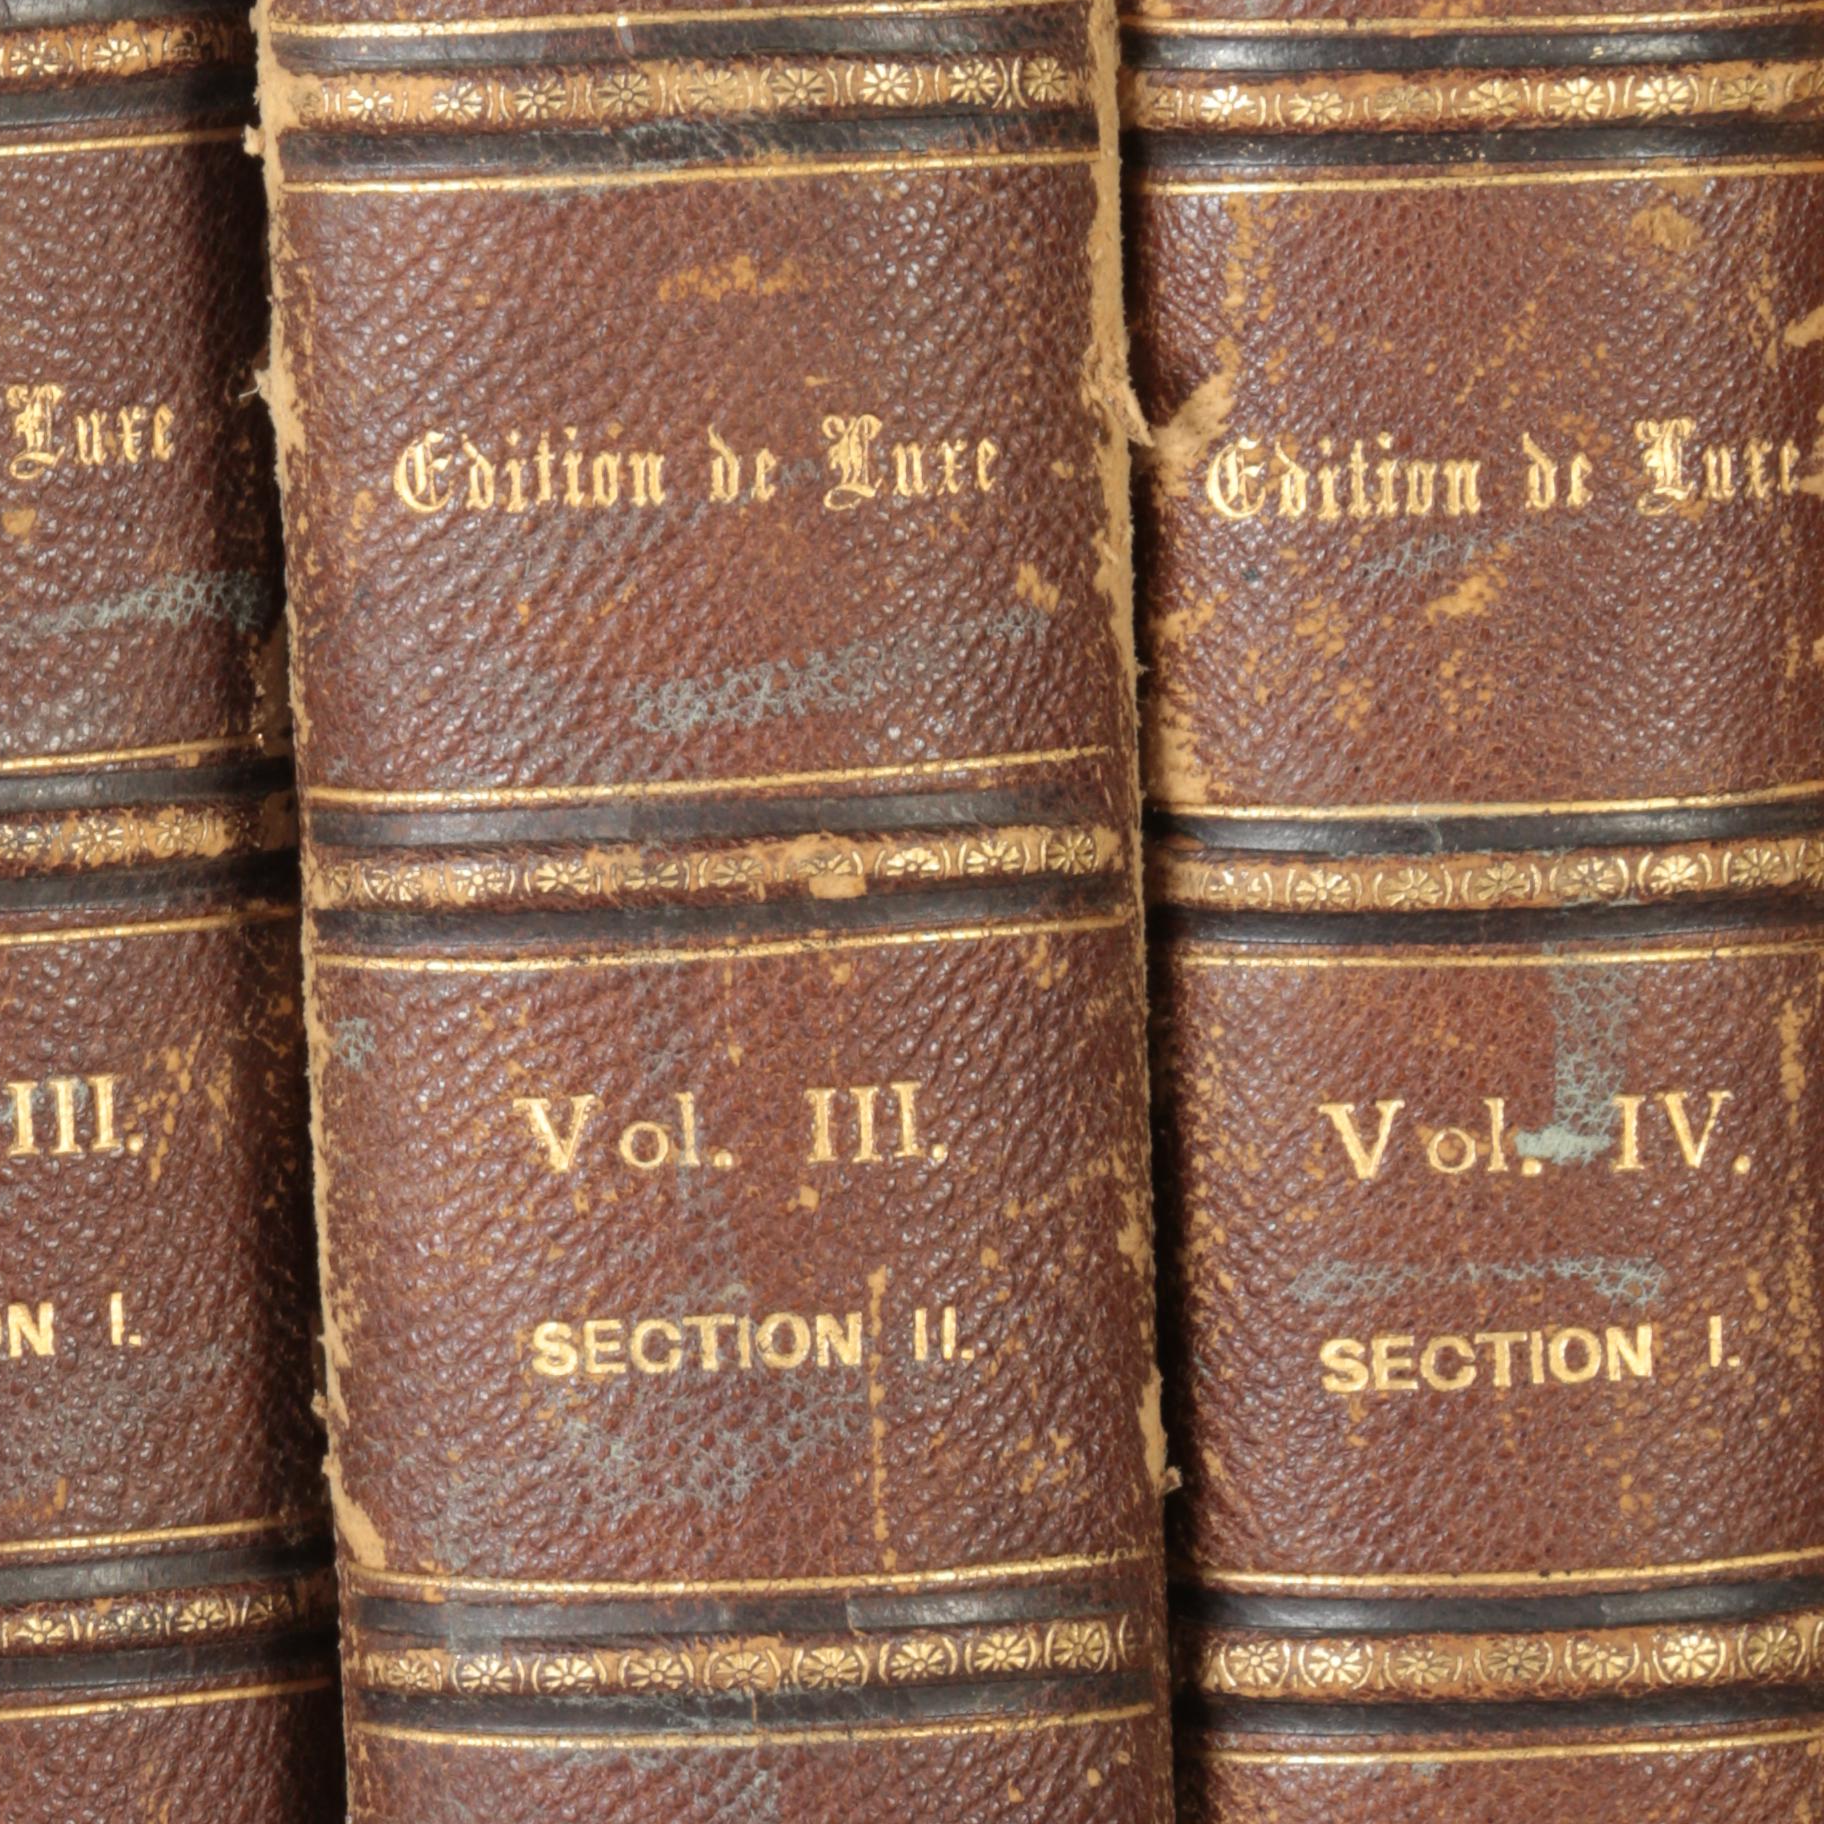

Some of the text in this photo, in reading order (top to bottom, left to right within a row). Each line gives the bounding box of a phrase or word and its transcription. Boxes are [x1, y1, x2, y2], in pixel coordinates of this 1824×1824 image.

[6, 382, 175, 480] Luxe
[393, 413, 999, 513] Edition de Luxe
[1206, 416, 1800, 520] Edition de Luxe
[7, 1075, 144, 1158] III.
[512, 1081, 948, 1173] Vol. III.
[1319, 1090, 1752, 1177] Vol. IV.
[110, 1292, 142, 1347] I.
[531, 1306, 975, 1377] SECTION II.
[1319, 1315, 1741, 1393] SECTION I.
